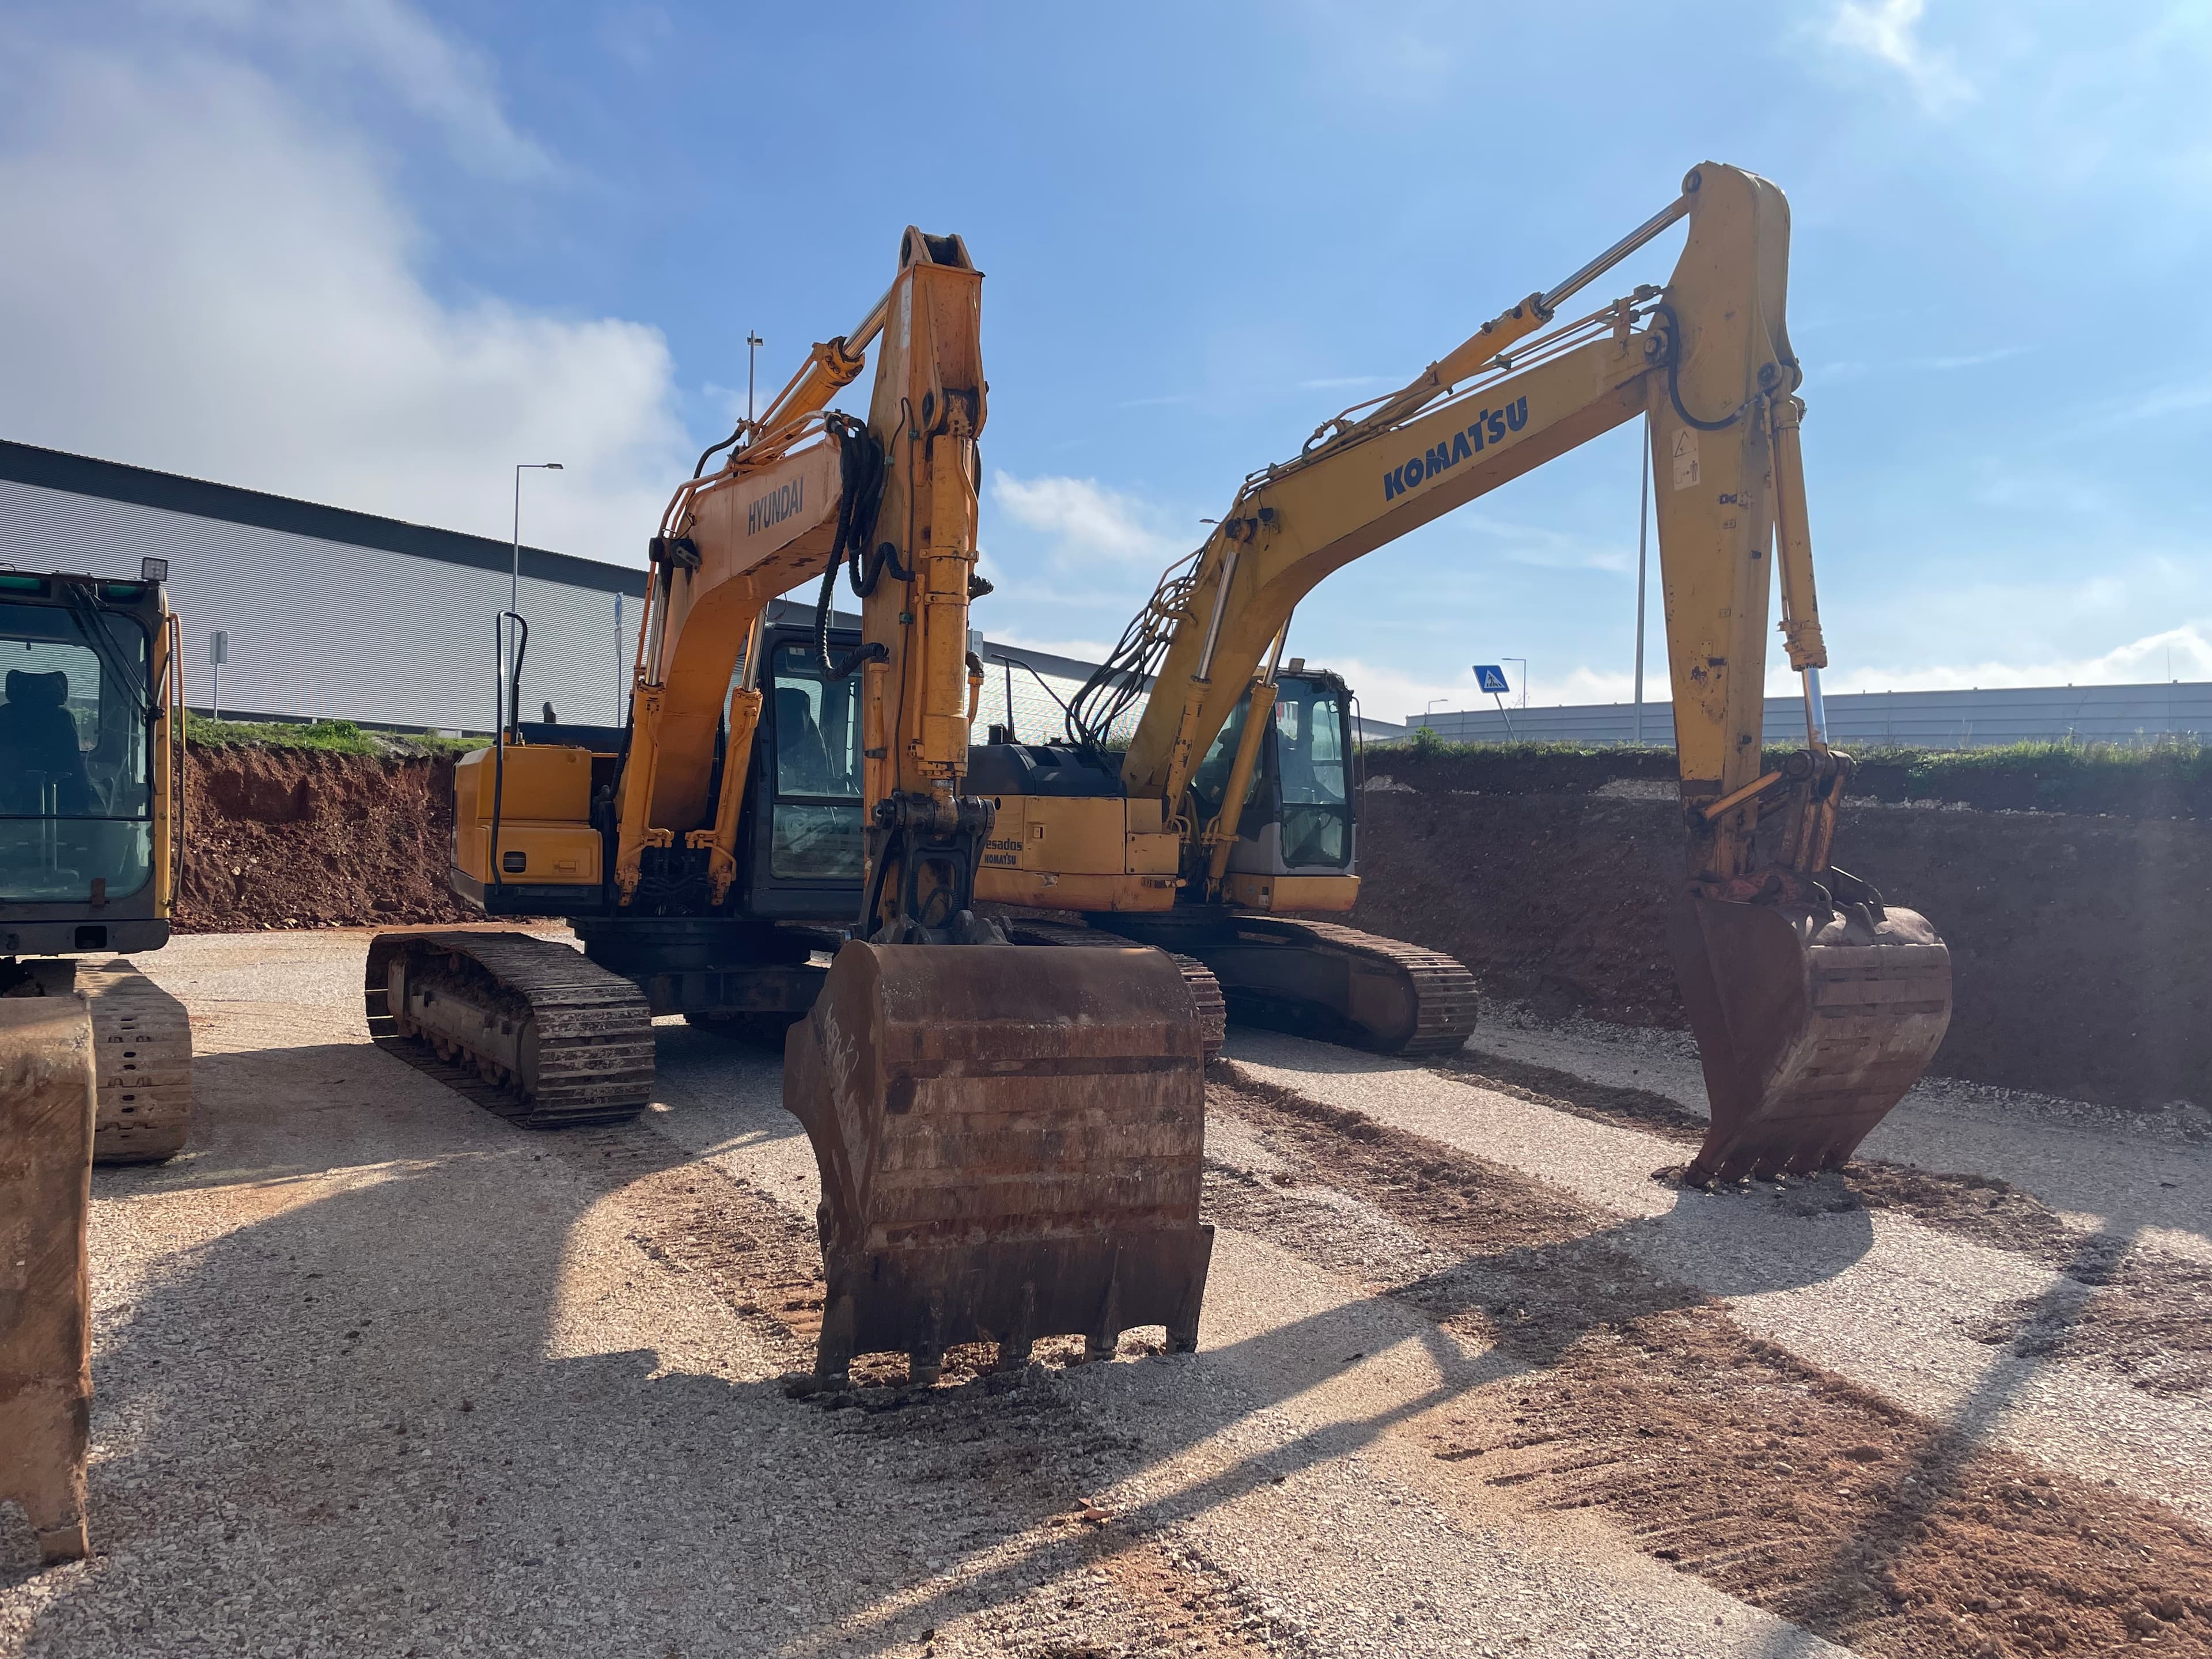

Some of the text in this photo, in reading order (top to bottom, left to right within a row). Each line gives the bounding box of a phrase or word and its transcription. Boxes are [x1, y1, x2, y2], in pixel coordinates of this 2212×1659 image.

[1383, 396, 1528, 502] KOMATSU
[748, 476, 804, 537] HYUNDAI
[984, 853, 1016, 865] KOMATSU
[986, 838, 1022, 851] esados
